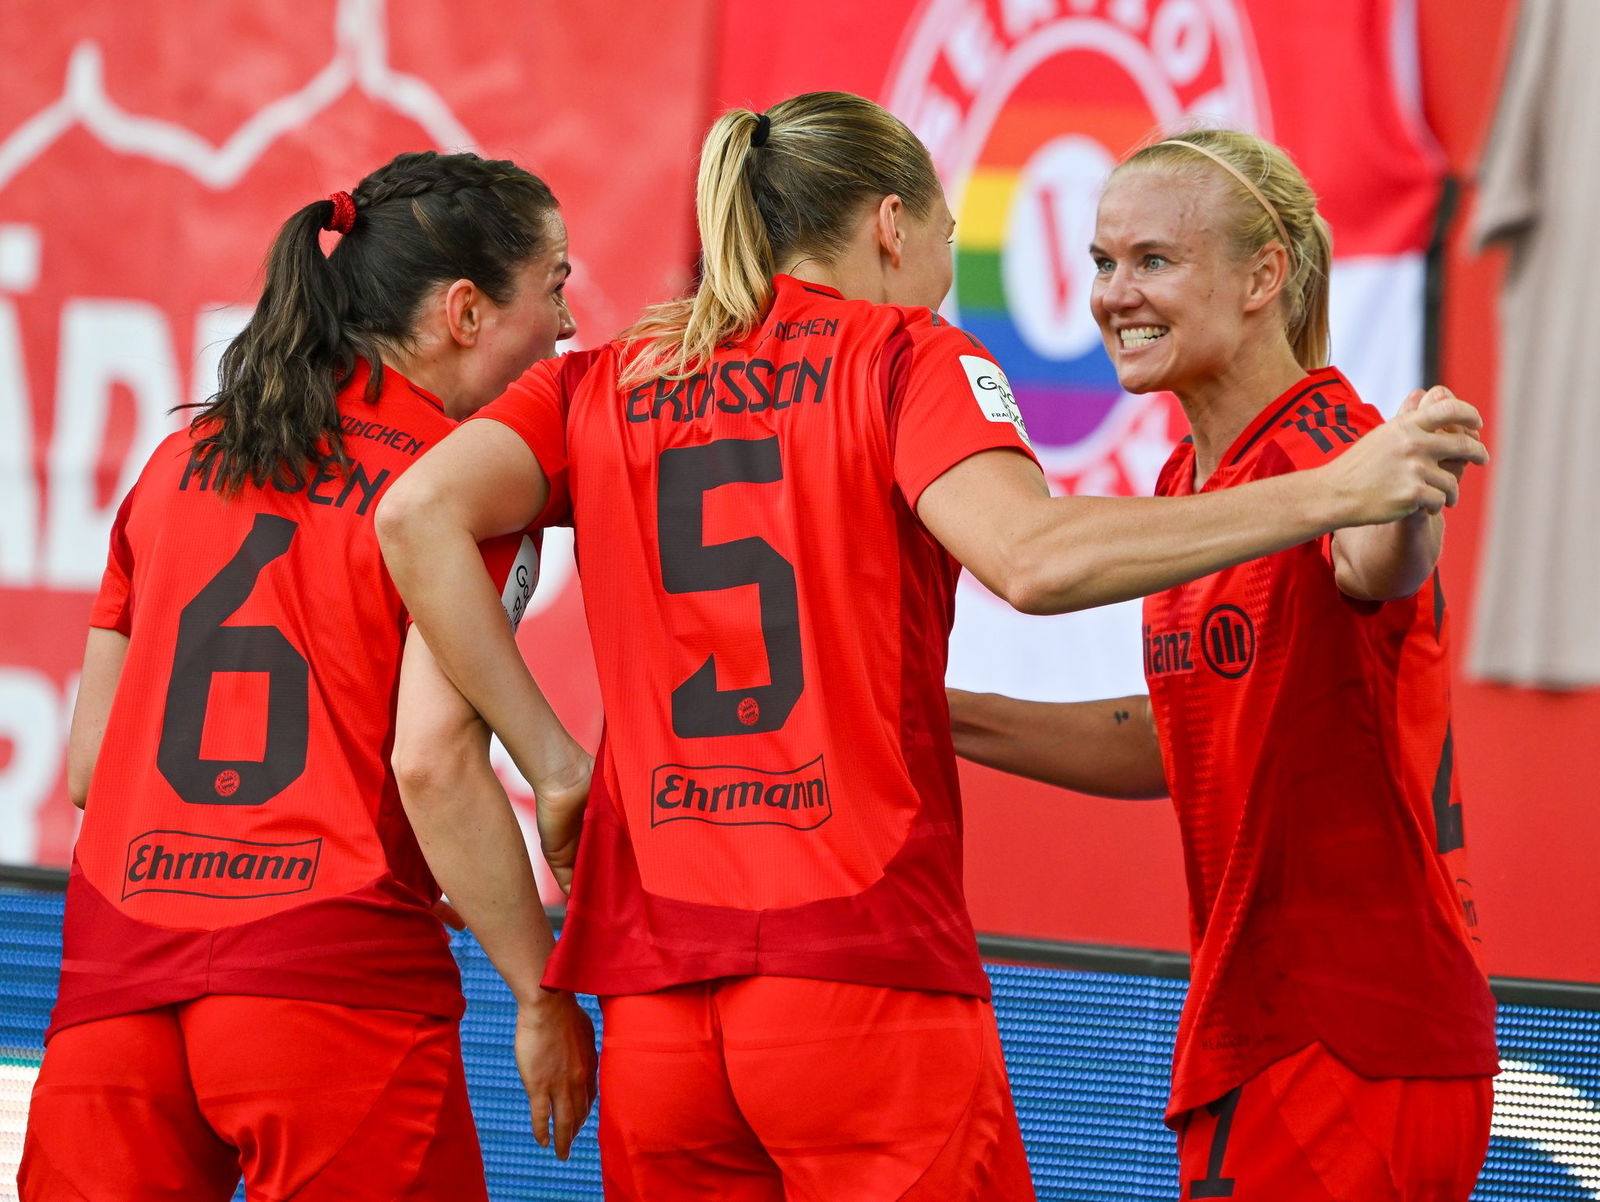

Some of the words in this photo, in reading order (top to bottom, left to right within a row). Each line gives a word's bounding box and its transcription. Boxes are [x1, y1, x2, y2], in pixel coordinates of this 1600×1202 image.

[775, 318, 840, 342] NCHEN
[657, 434, 805, 739] 5
[157, 512, 309, 806] 6
[655, 773, 825, 813] Ehrmann
[128, 844, 312, 882] Ehrmann
